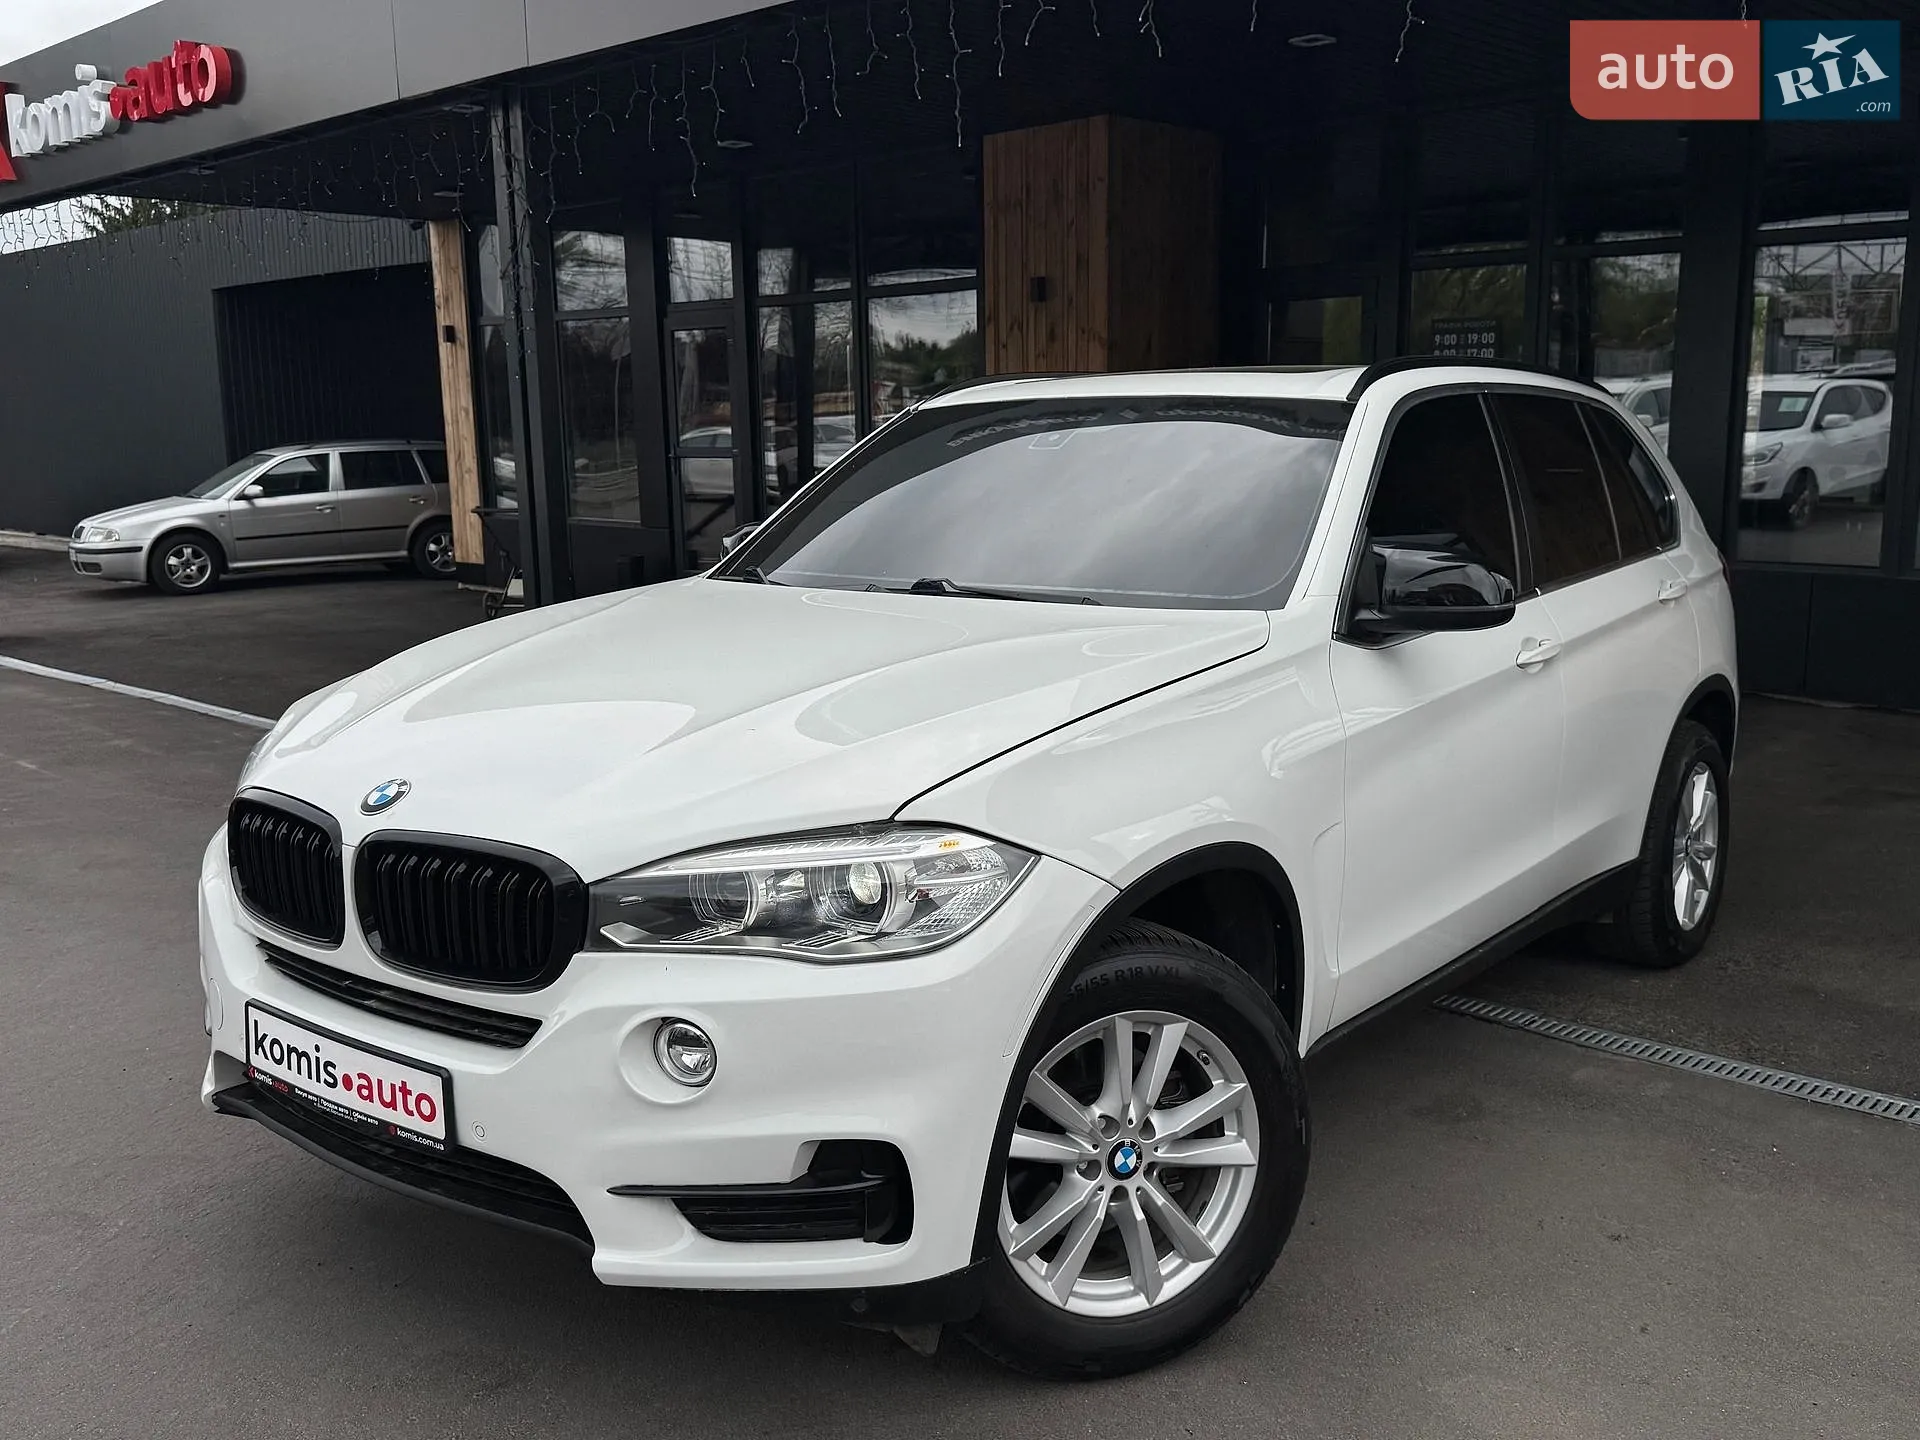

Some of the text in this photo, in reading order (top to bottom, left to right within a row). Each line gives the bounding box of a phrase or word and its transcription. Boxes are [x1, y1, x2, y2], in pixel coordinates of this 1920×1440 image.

[1434, 332, 1495, 346] 9:00 19:00
[1115, 966, 1144, 982] R18
[396, 1127, 445, 1151] komis.com.ua
